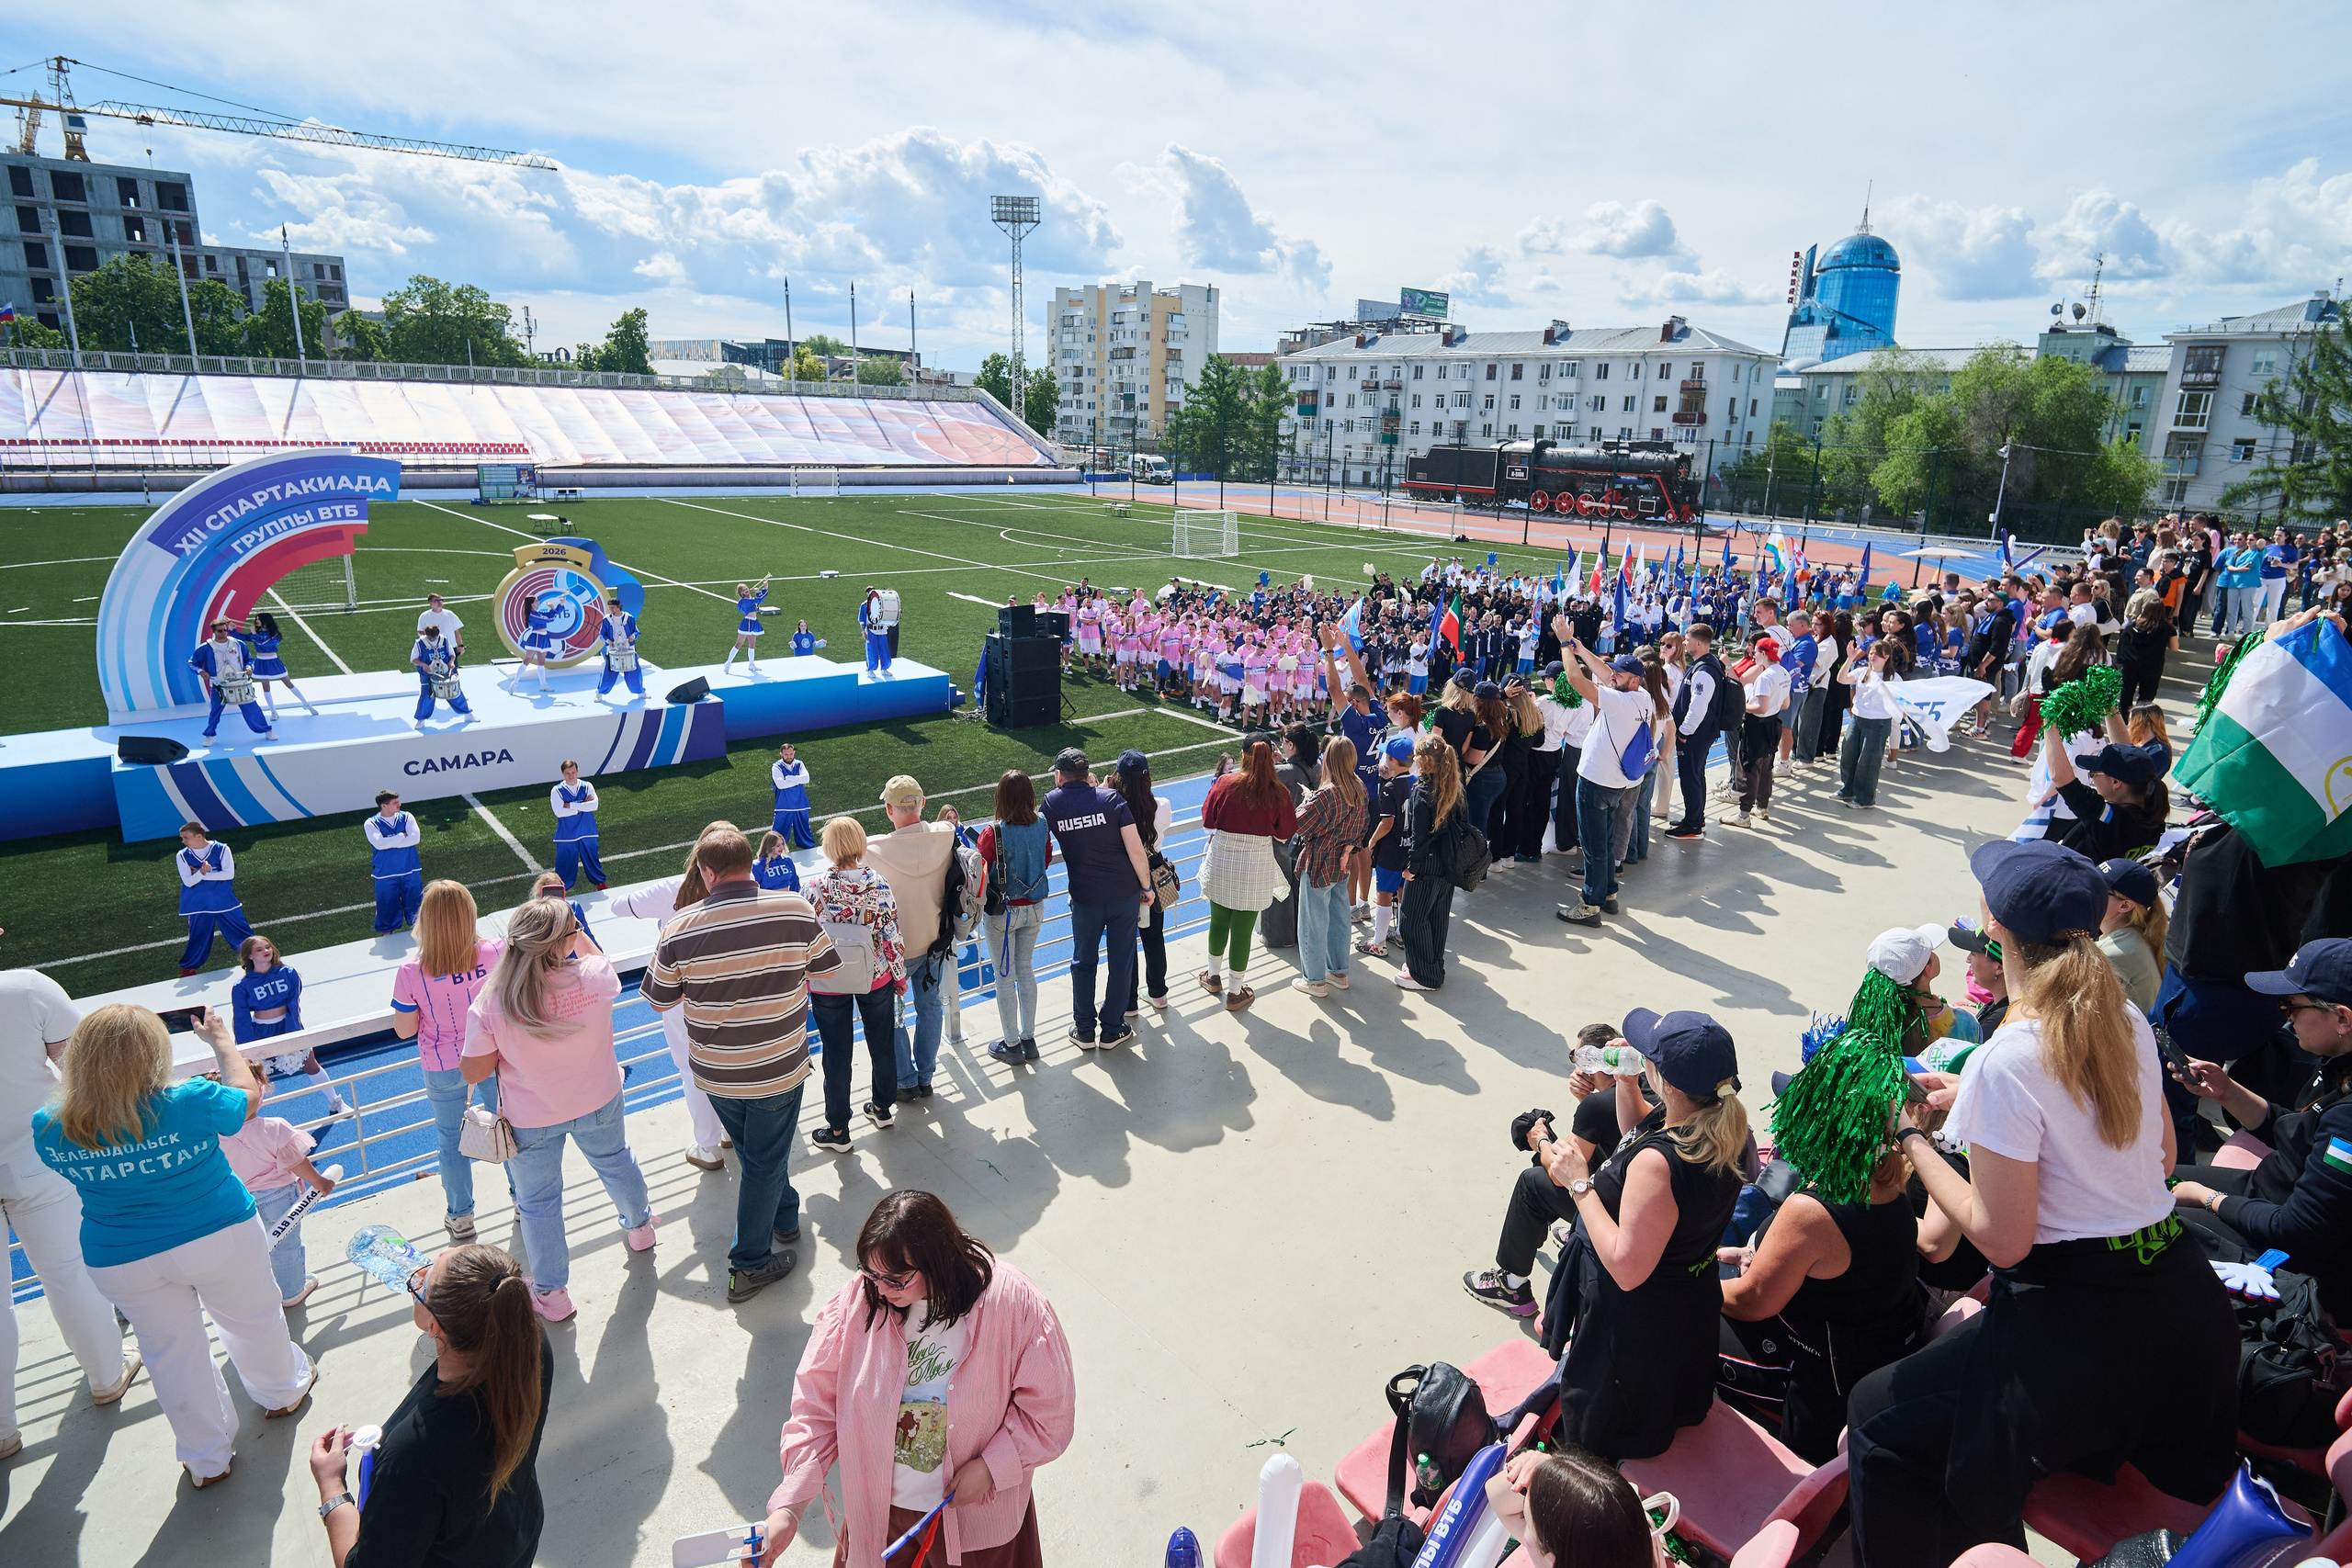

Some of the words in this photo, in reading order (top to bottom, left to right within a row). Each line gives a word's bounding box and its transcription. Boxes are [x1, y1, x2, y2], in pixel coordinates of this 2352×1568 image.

[174, 526, 209, 557] XII
[205, 475, 392, 531] СПАРТАКИАДА
[231, 510, 315, 555] ГРУППЫ
[317, 504, 359, 520] ВТБ
[542, 547, 567, 556] 2026
[403, 749, 514, 776] САМАРА
[1057, 812, 1107, 832] RUSSIA
[254, 978, 288, 1000] ВТБ
[563, 992, 583, 1002] when
[567, 986, 586, 996] more
[561, 993, 599, 1010] definition
[272, 1220, 290, 1238] ВТБ
[1433, 1498, 1463, 1540] ВТБ
